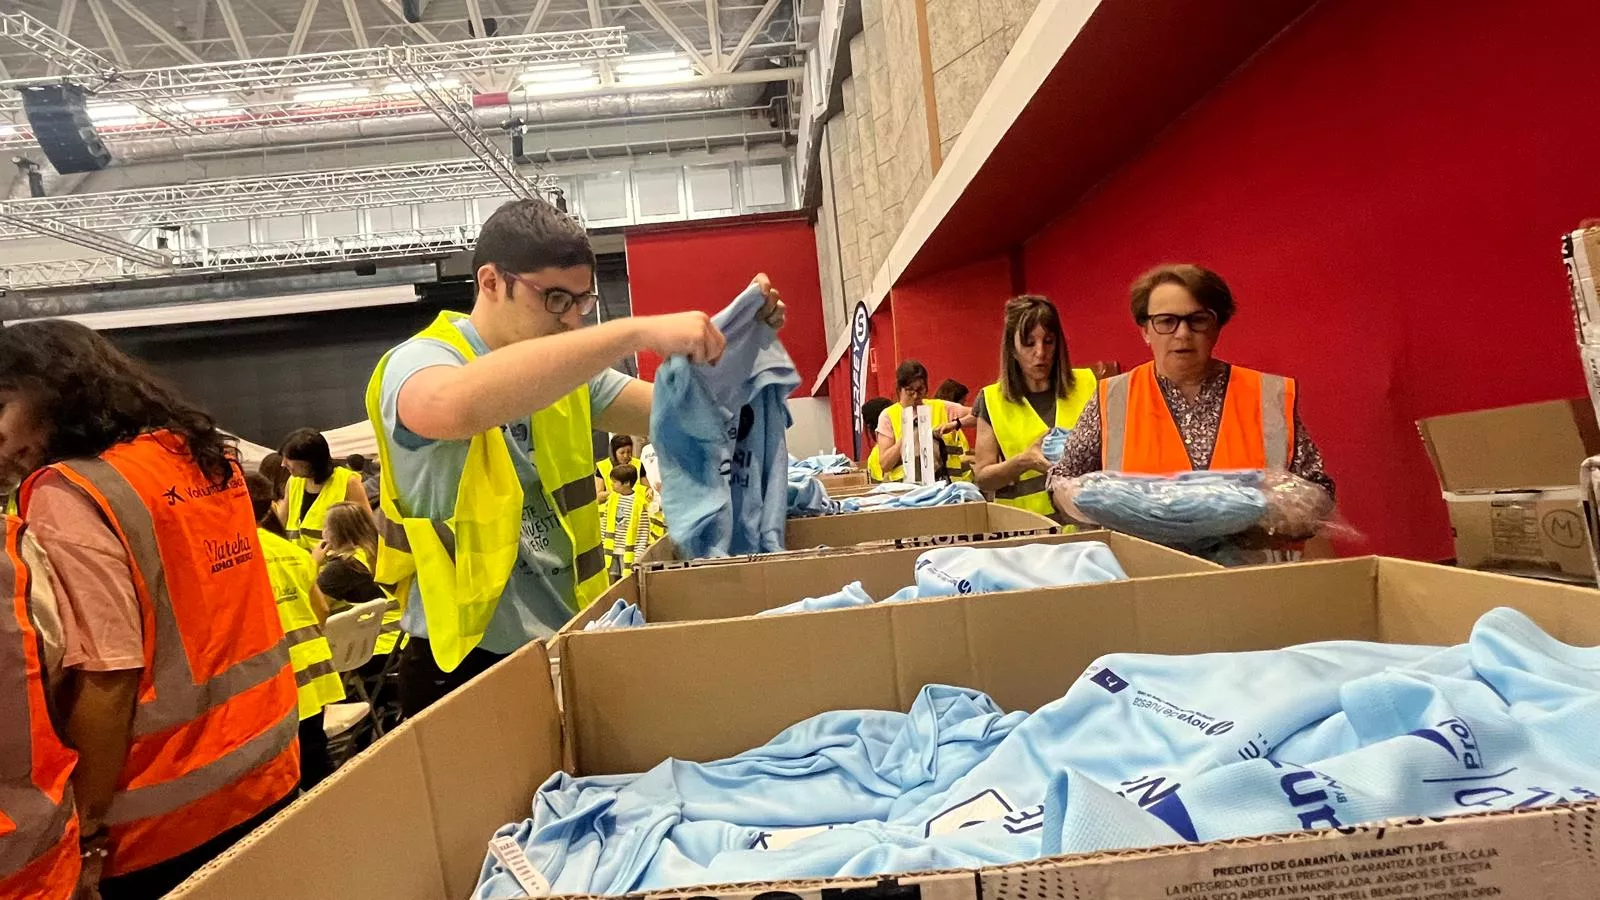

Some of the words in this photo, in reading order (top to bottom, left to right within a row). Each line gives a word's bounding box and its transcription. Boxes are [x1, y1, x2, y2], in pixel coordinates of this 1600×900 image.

[1166, 884, 1180, 896] LA
[1182, 878, 1249, 894] INTEGRIDAD
[1250, 875, 1265, 887] DE
[1267, 872, 1292, 885] ESTE
[1296, 866, 1349, 881] PRECINTO
[1352, 859, 1413, 874] GARANTIZA
[1415, 855, 1438, 867] QUE
[1441, 852, 1468, 863] ESTA
[1213, 864, 1269, 877] PRECINTO
[1271, 861, 1287, 871] DE
[1352, 845, 1415, 860] WARRANTY
[1241, 887, 1286, 900] ABIERTA
